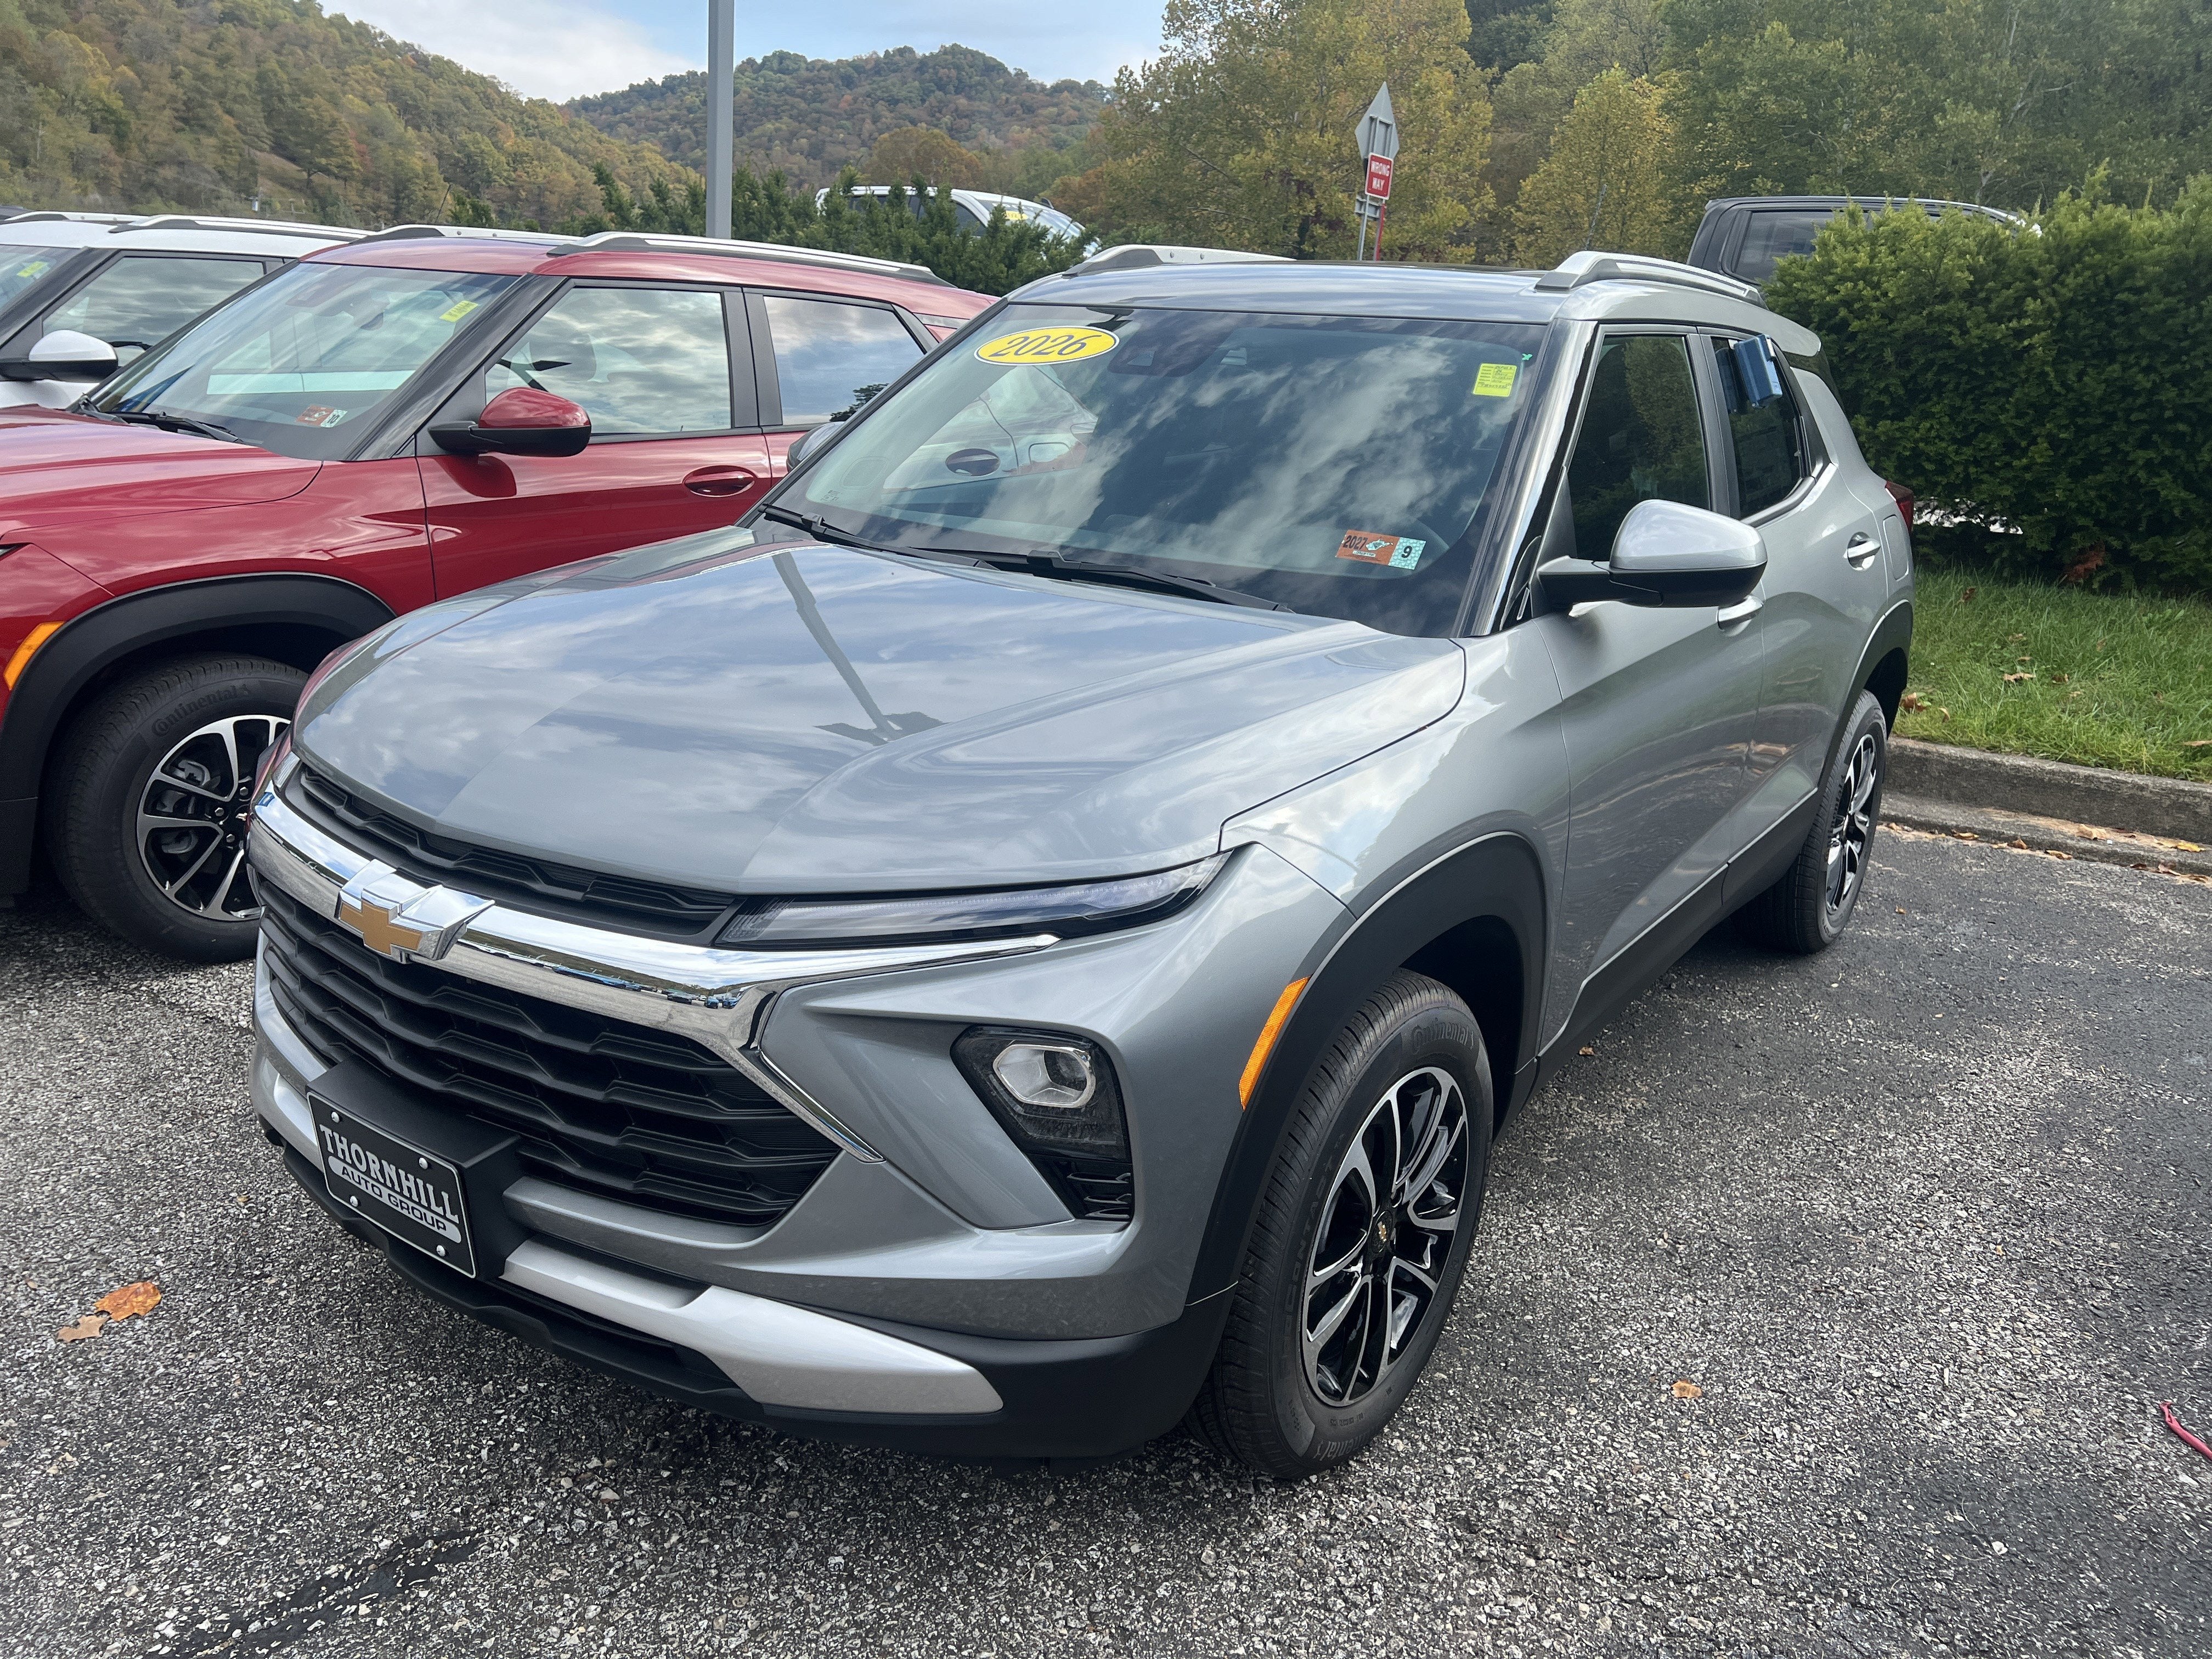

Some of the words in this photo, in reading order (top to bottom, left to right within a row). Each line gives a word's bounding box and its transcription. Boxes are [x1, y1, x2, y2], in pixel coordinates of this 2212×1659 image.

[1371, 160, 1390, 177] WRONG
[1372, 177, 1385, 191] WAY
[988, 335, 1102, 357] 2026
[327, 414, 340, 424] 10
[1343, 535, 1368, 550] 2027
[1401, 545, 1413, 558] 9
[153, 685, 238, 736] Continental
[1412, 1016, 1469, 1056] Continental
[319, 1124, 459, 1224] THORNHILL
[341, 1165, 383, 1199] AUTO
[387, 1193, 447, 1232] GROUP
